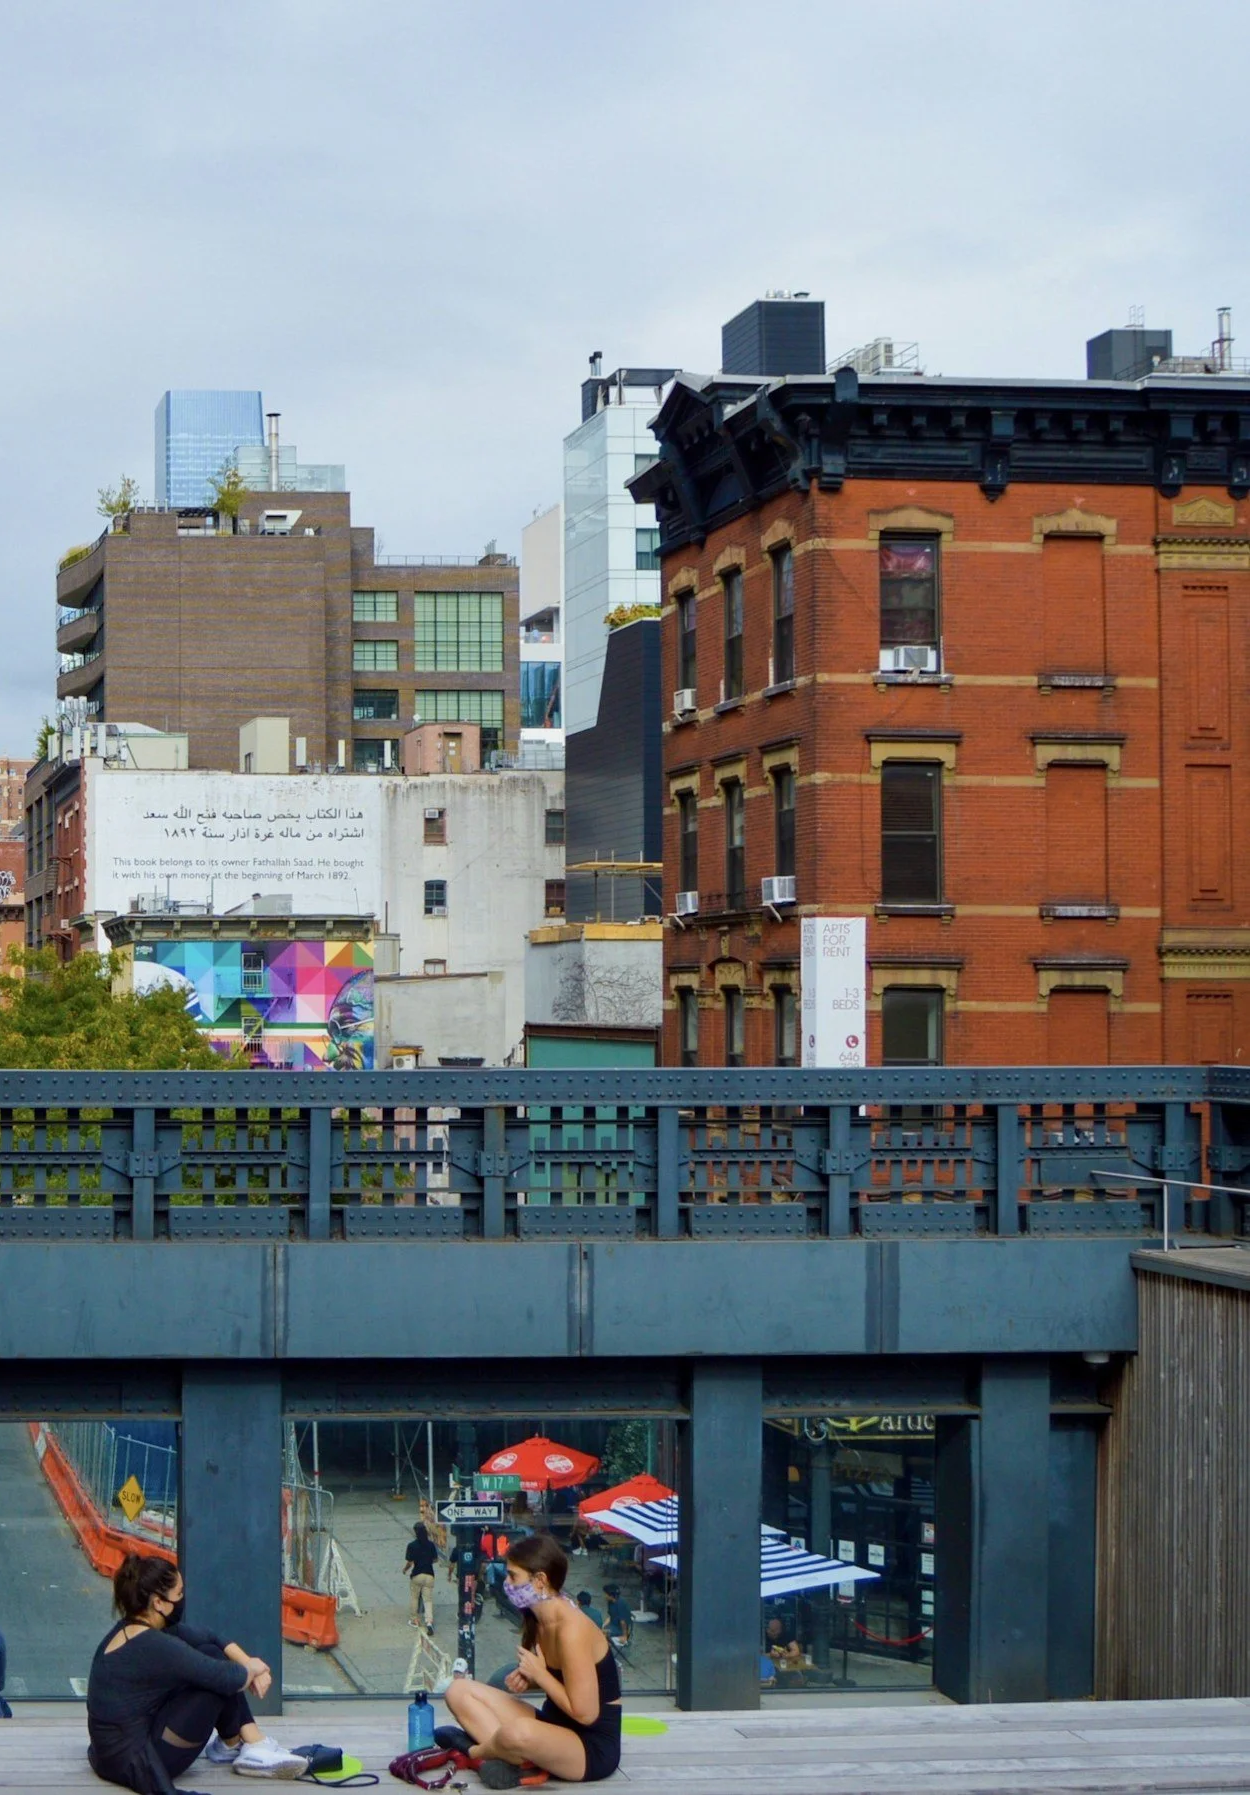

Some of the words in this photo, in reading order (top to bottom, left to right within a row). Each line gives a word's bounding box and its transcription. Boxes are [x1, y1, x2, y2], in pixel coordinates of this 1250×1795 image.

[142, 810, 169, 820] سعد
[172, 804, 192, 820] الله
[196, 808, 217, 825] فتح
[221, 808, 263, 823] صاحبه
[266, 808, 301, 823] يخص
[305, 807, 342, 824] الكتاب
[345, 807, 364, 820] هذا
[201, 826, 225, 839] سنة
[278, 826, 302, 839] ماله
[305, 829, 323, 842] من
[327, 827, 365, 842] اشتراه
[113, 857, 132, 867] This
[134, 857, 157, 867] book
[159, 857, 193, 869] belongs
[195, 859, 206, 867] to
[208, 858, 219, 867] its
[252, 857, 291, 867] Fathallah
[317, 857, 331, 867] He
[333, 858, 365, 869] bought
[112, 870, 119, 879] it
[121, 870, 141, 880] with
[143, 870, 156, 880] his
[158, 872, 178, 880] own
[180, 872, 210, 882] money
[213, 872, 222, 880] at
[224, 870, 239, 880] the
[241, 870, 283, 882] beginning
[285, 870, 295, 880] of
[296, 870, 325, 880] March
[822, 923, 851, 934] APTS
[823, 934, 846, 946] FOR
[822, 946, 851, 957] RENT
[844, 987, 859, 998] 1-3
[832, 1000, 860, 1010] BEDS
[838, 1051, 860, 1062] 646
[482, 1476, 491, 1489] W
[493, 1476, 503, 1489] 17
[122, 1490, 141, 1504] SLOW
[447, 1508, 465, 1516] ONE
[474, 1508, 494, 1516] WAY
